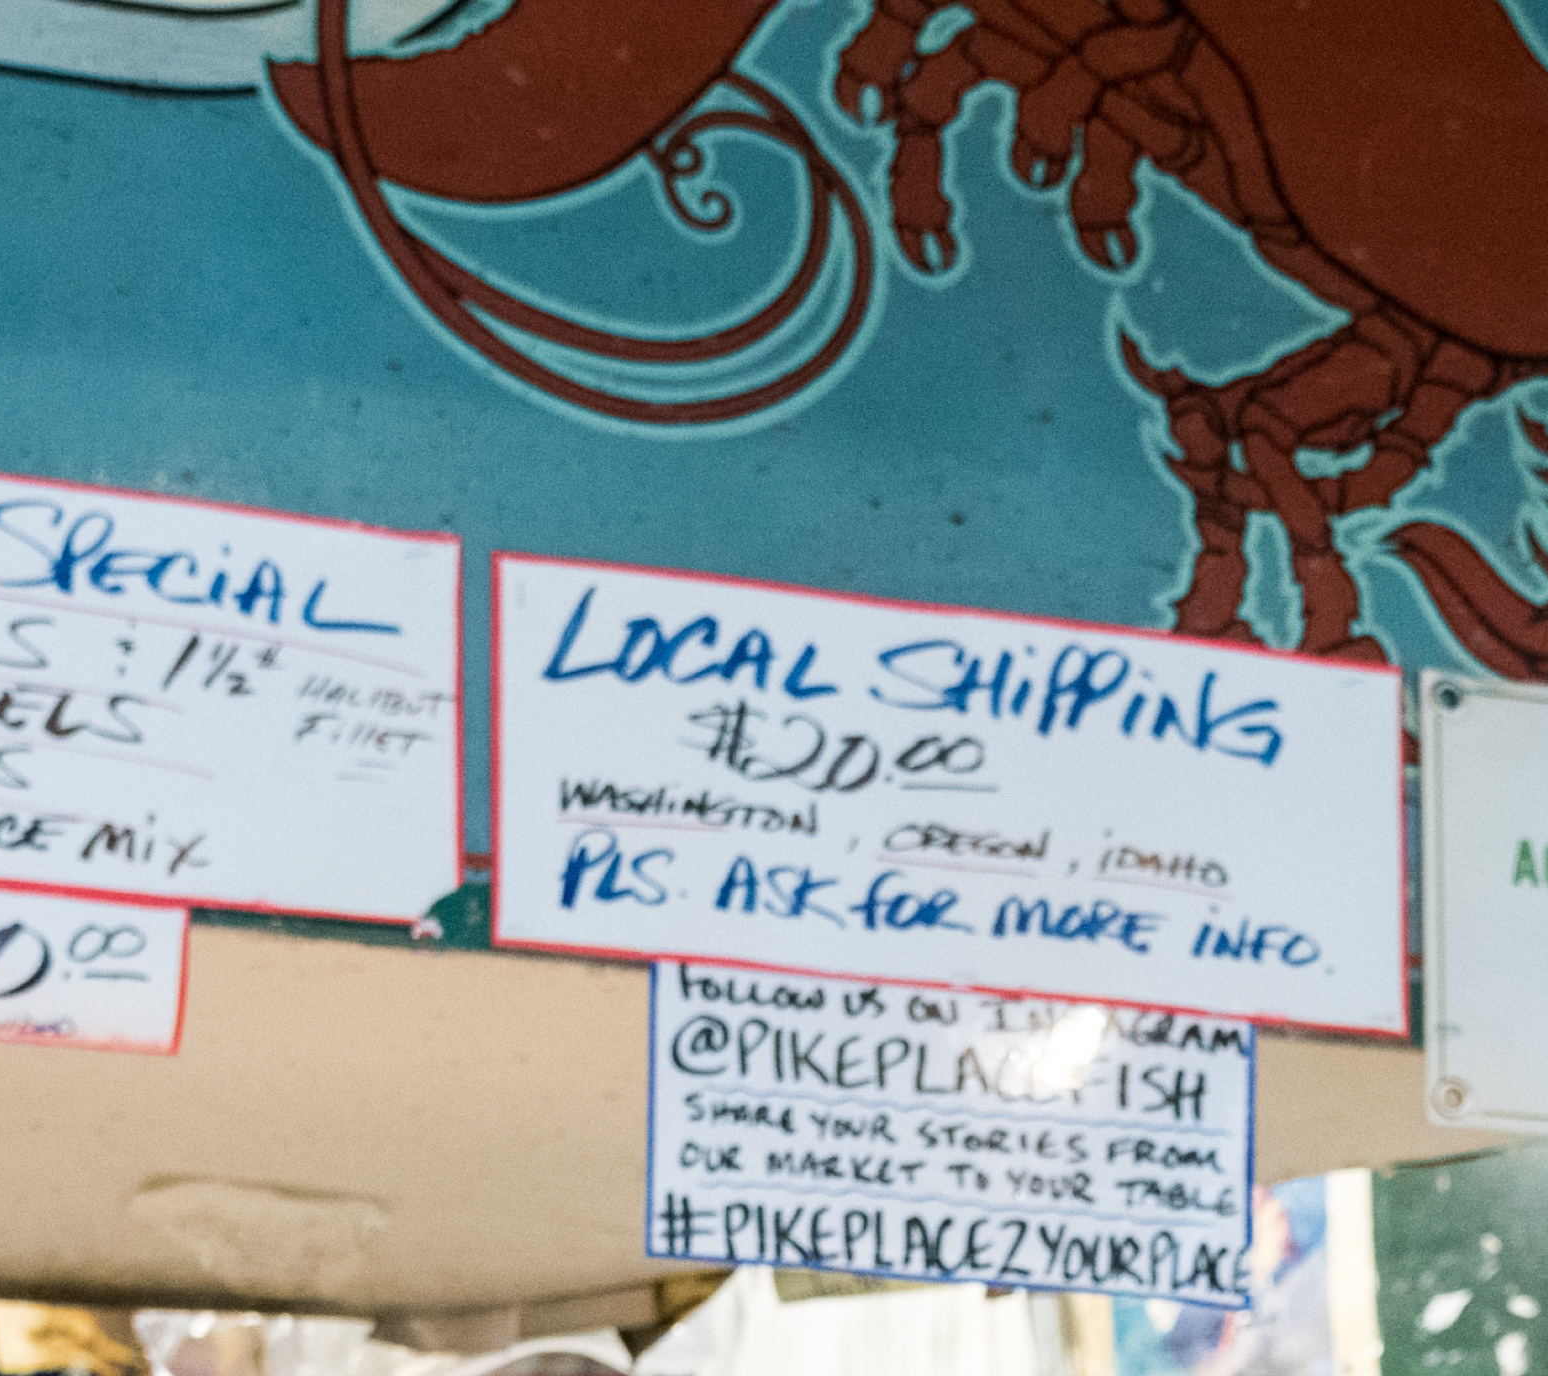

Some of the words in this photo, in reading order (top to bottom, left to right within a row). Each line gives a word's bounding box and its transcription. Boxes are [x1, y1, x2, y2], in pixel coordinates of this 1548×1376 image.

[540, 585, 838, 699] LOCAL
[712, 855, 848, 926] ASK
[992, 896, 1168, 954] MORE
[843, 988, 886, 1019] US
[684, 1092, 796, 1135] SHARE
[809, 1110, 899, 1146] YOUR
[917, 1120, 1089, 1164] STORIES
[1107, 1133, 1226, 1174] FROM
[679, 1140, 743, 1173] OUR
[765, 1150, 926, 1189] MARKET
[947, 1161, 990, 1193] TO
[1006, 1168, 1097, 1204] YOUR
[1114, 1176, 1239, 1218] TABLE
